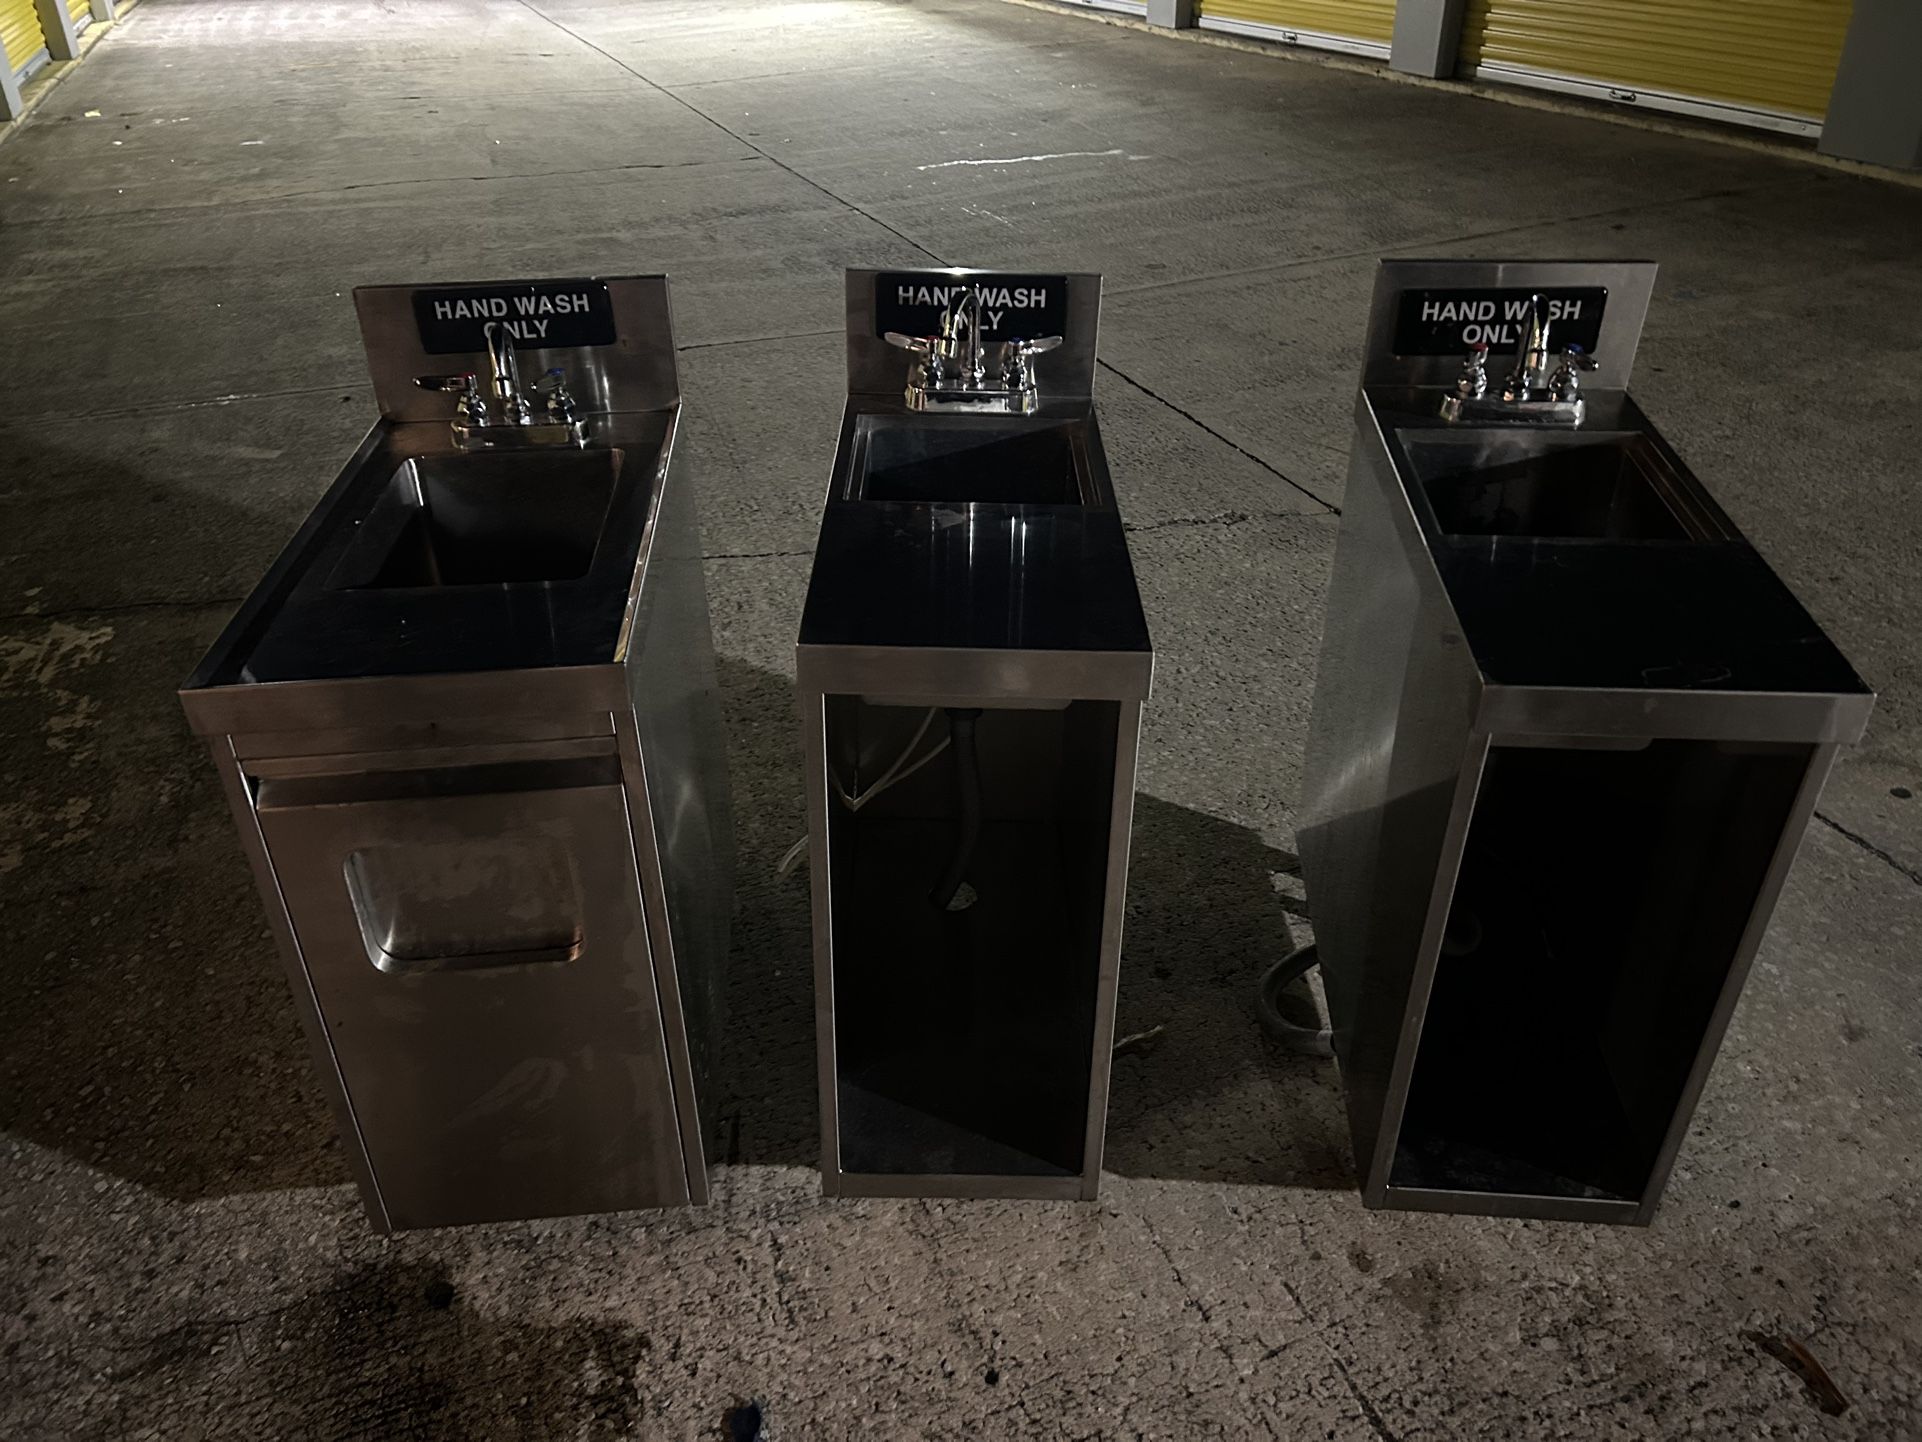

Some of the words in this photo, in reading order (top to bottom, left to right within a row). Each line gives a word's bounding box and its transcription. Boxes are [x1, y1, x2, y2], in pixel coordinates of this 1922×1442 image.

[433, 298, 508, 320] HAND
[513, 293, 590, 316] WASH
[974, 287, 1047, 308] WASH
[939, 309, 1004, 331] NY
[1421, 300, 1496, 322] HAND
[1504, 299, 1582, 321] WSH
